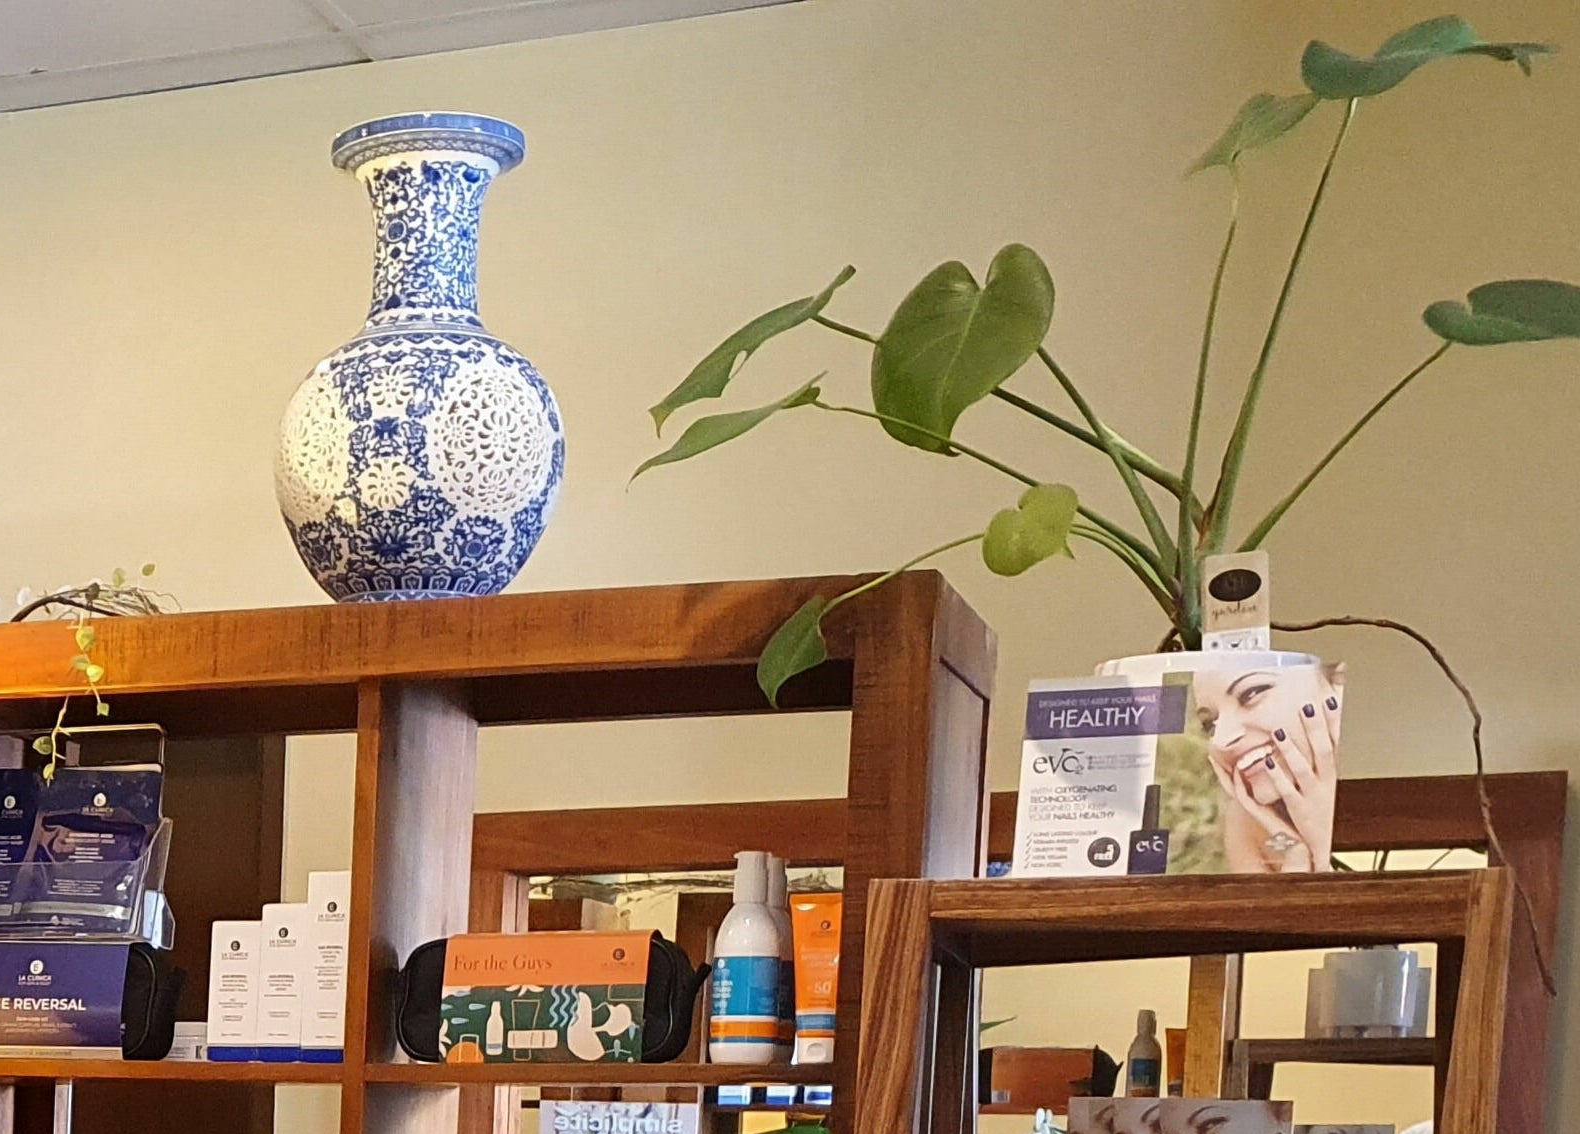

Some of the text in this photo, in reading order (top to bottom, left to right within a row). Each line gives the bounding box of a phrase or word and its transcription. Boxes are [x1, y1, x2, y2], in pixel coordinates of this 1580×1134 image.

[1049, 706, 1145, 729] HEALTHY
[1054, 784, 1118, 794] OXYGENATING
[1030, 795, 1088, 804] TECHNOLOGY
[1053, 812, 1077, 820] NAILS
[1080, 811, 1115, 820] HEALTHY
[453, 954, 554, 974] For the Guys
[13, 998, 87, 1011] REVERSAL
